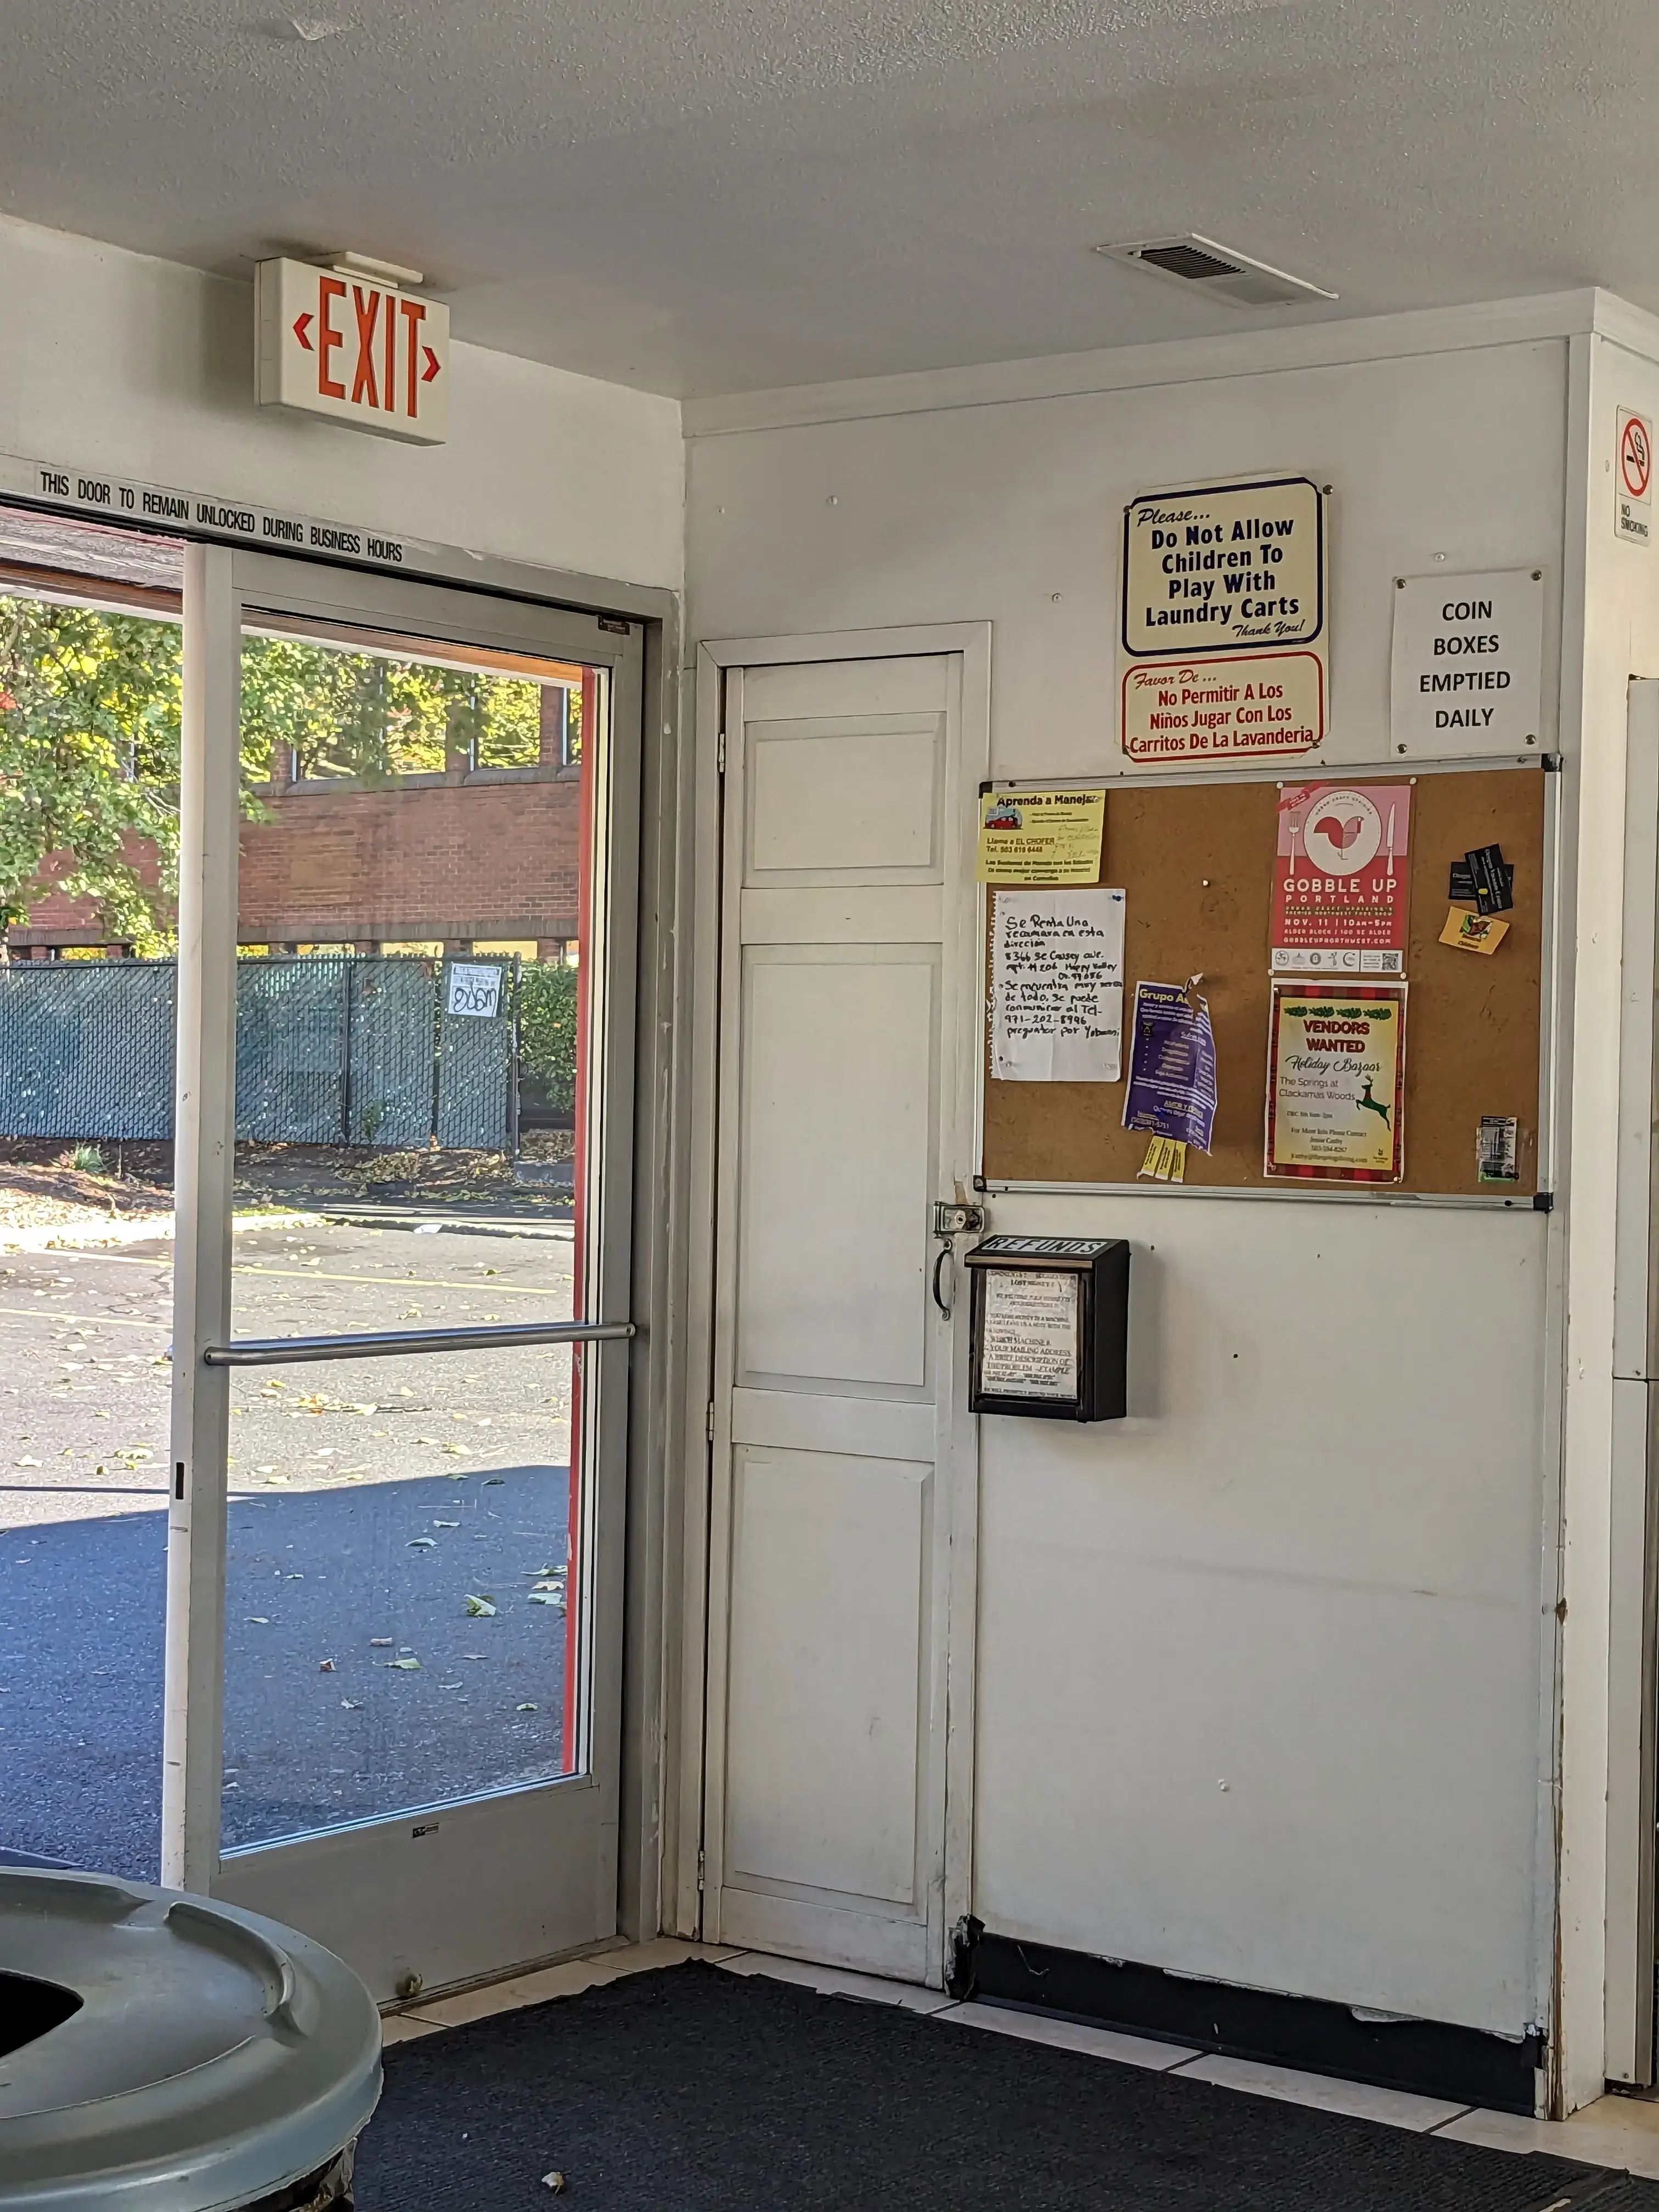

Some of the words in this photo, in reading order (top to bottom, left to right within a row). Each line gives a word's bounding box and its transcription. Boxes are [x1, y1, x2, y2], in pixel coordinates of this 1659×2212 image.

[319, 276, 427, 419] EXIT
[41, 471, 70, 496] THIS
[78, 478, 111, 505] DOOR
[119, 487, 135, 510] TO
[143, 493, 189, 521] REMAIN
[197, 503, 255, 533] UNLOCKED
[263, 516, 303, 543] DURING
[311, 526, 360, 554] BUSINESS
[367, 538, 402, 562] HOURS
[1137, 508, 1210, 527] Please...
[1621, 504, 1630, 517] NO
[1152, 530, 1177, 549] Do
[1186, 525, 1223, 546] Not
[1231, 519, 1294, 541] Allow
[1621, 517, 1648, 537] SMOKING
[1162, 550, 1251, 574] Children
[1260, 544, 1283, 564] To
[1169, 579, 1215, 600] Play
[1223, 571, 1275, 594] With
[1146, 602, 1232, 627] Laundry
[1241, 598, 1299, 618] Carts
[1442, 601, 1492, 621] COIN
[1232, 622, 1272, 638] Thank
[1274, 619, 1306, 636] You!
[1434, 635, 1499, 655] BOXES
[1134, 673, 1175, 689] Favor
[1420, 671, 1510, 692] EMPTIED
[1159, 690, 1177, 707] No
[1182, 685, 1239, 704] Permitir
[1244, 684, 1254, 700] A
[1259, 683, 1283, 699] Los
[1150, 712, 1188, 730] Niños
[1191, 710, 1232, 729] Jugar
[1236, 707, 1263, 723] Con
[1268, 706, 1292, 721] Los
[1436, 708, 1494, 728] DAILY
[1130, 735, 1185, 753] Carritos
[1189, 733, 1208, 749] De
[1213, 732, 1228, 747] La
[1233, 726, 1313, 746] Lavanderia
[997, 795, 1042, 807] Aprenda
[1283, 879, 1361, 893] GOBBLE
[1373, 879, 1397, 893] UP
[1005, 917, 1026, 930] Se
[1030, 914, 1064, 928] Renta
[1066, 916, 1088, 927] Una
[1079, 927, 1104, 937] esta
[1005, 980, 1018, 990] Se
[1074, 982, 1096, 992] muy
[1139, 989, 1173, 1002] Grupo
[1005, 992, 1015, 1001] de
[1070, 994, 1099, 1005] puede
[1066, 1005, 1077, 1013] al
[1061, 1028, 1080, 1037] por
[1303, 1019, 1370, 1035] VENDORS
[1306, 1038, 1365, 1053] WANTED
[1285, 1055, 1330, 1075] Holiday
[1334, 1058, 1381, 1077] Bazaar
[1298, 1078, 1328, 1088] Springs
[1279, 1089, 1325, 1098] Clackamas
[1327, 1092, 1356, 1101] Woods
[987, 1238, 1102, 1253] REFUNDS
